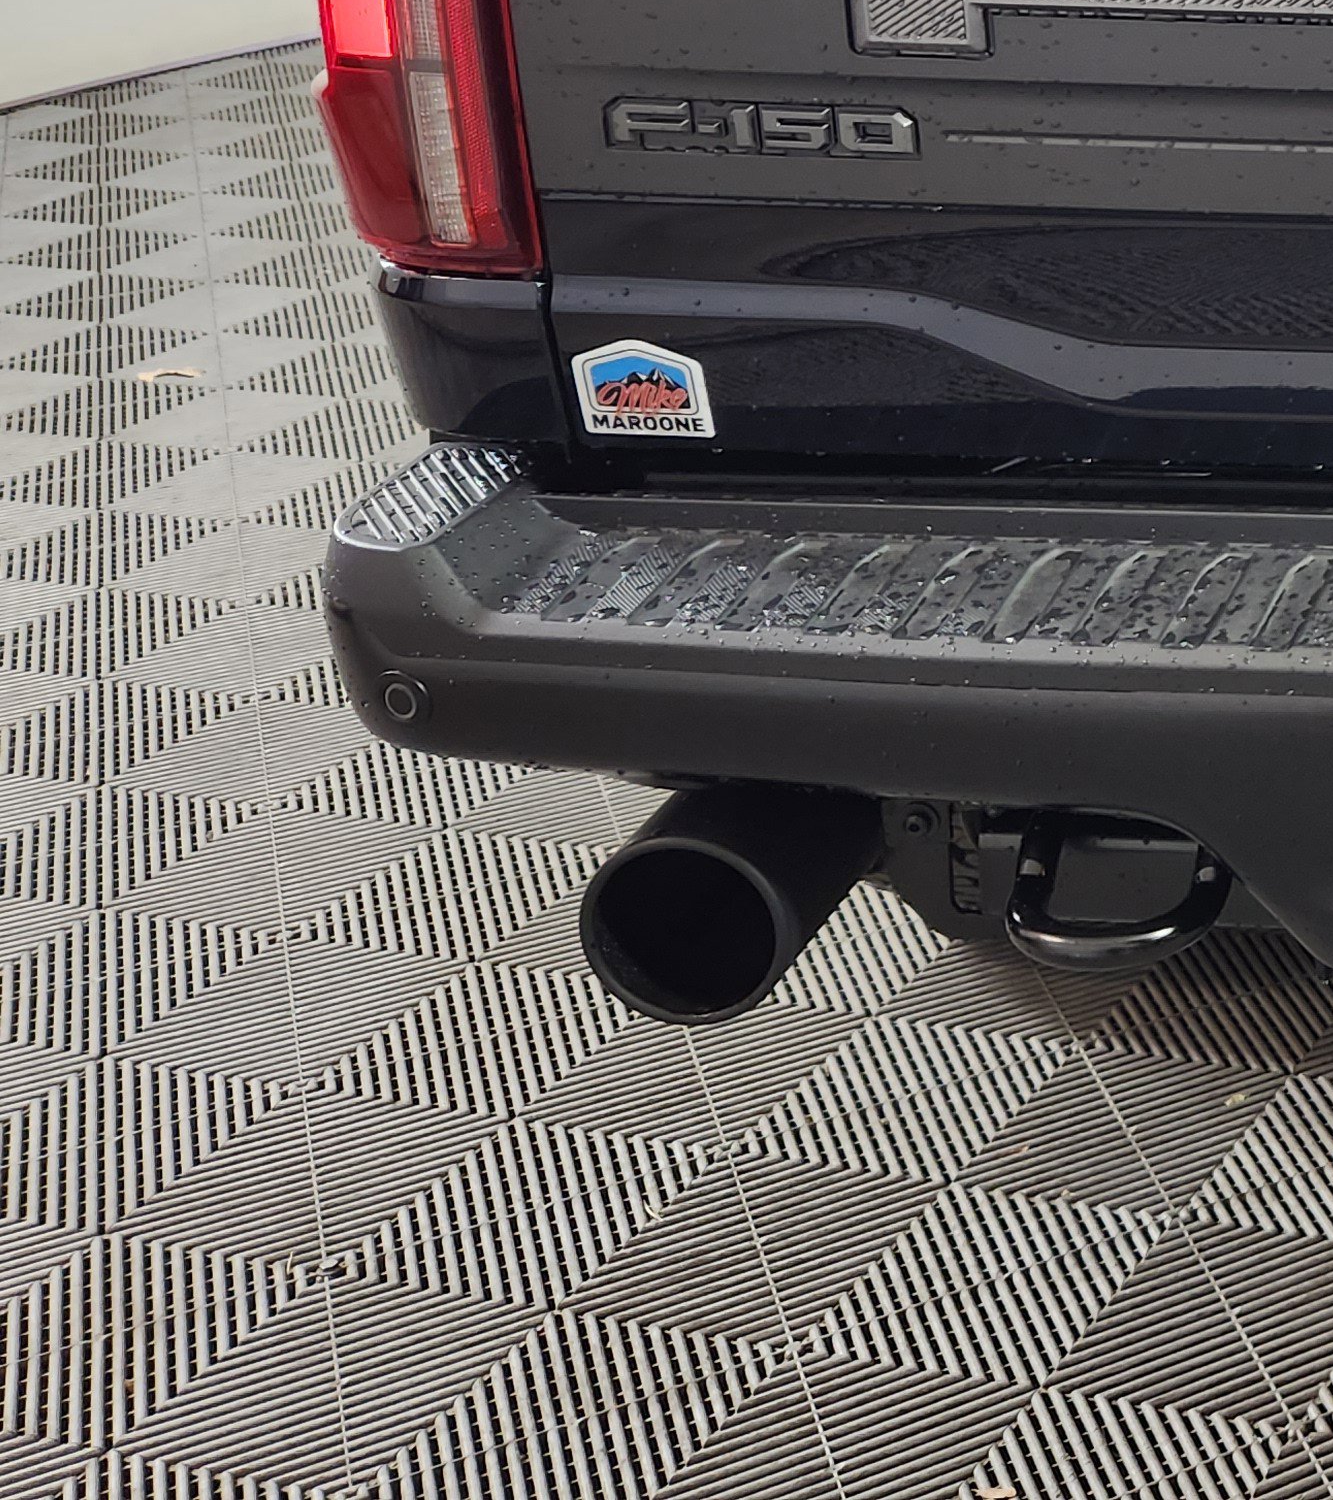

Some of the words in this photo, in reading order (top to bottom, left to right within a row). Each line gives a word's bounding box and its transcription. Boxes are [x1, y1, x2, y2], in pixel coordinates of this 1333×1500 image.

[603, 96, 922, 160] F-150
[597, 380, 688, 416] Mike
[591, 414, 706, 433] MAROONE
